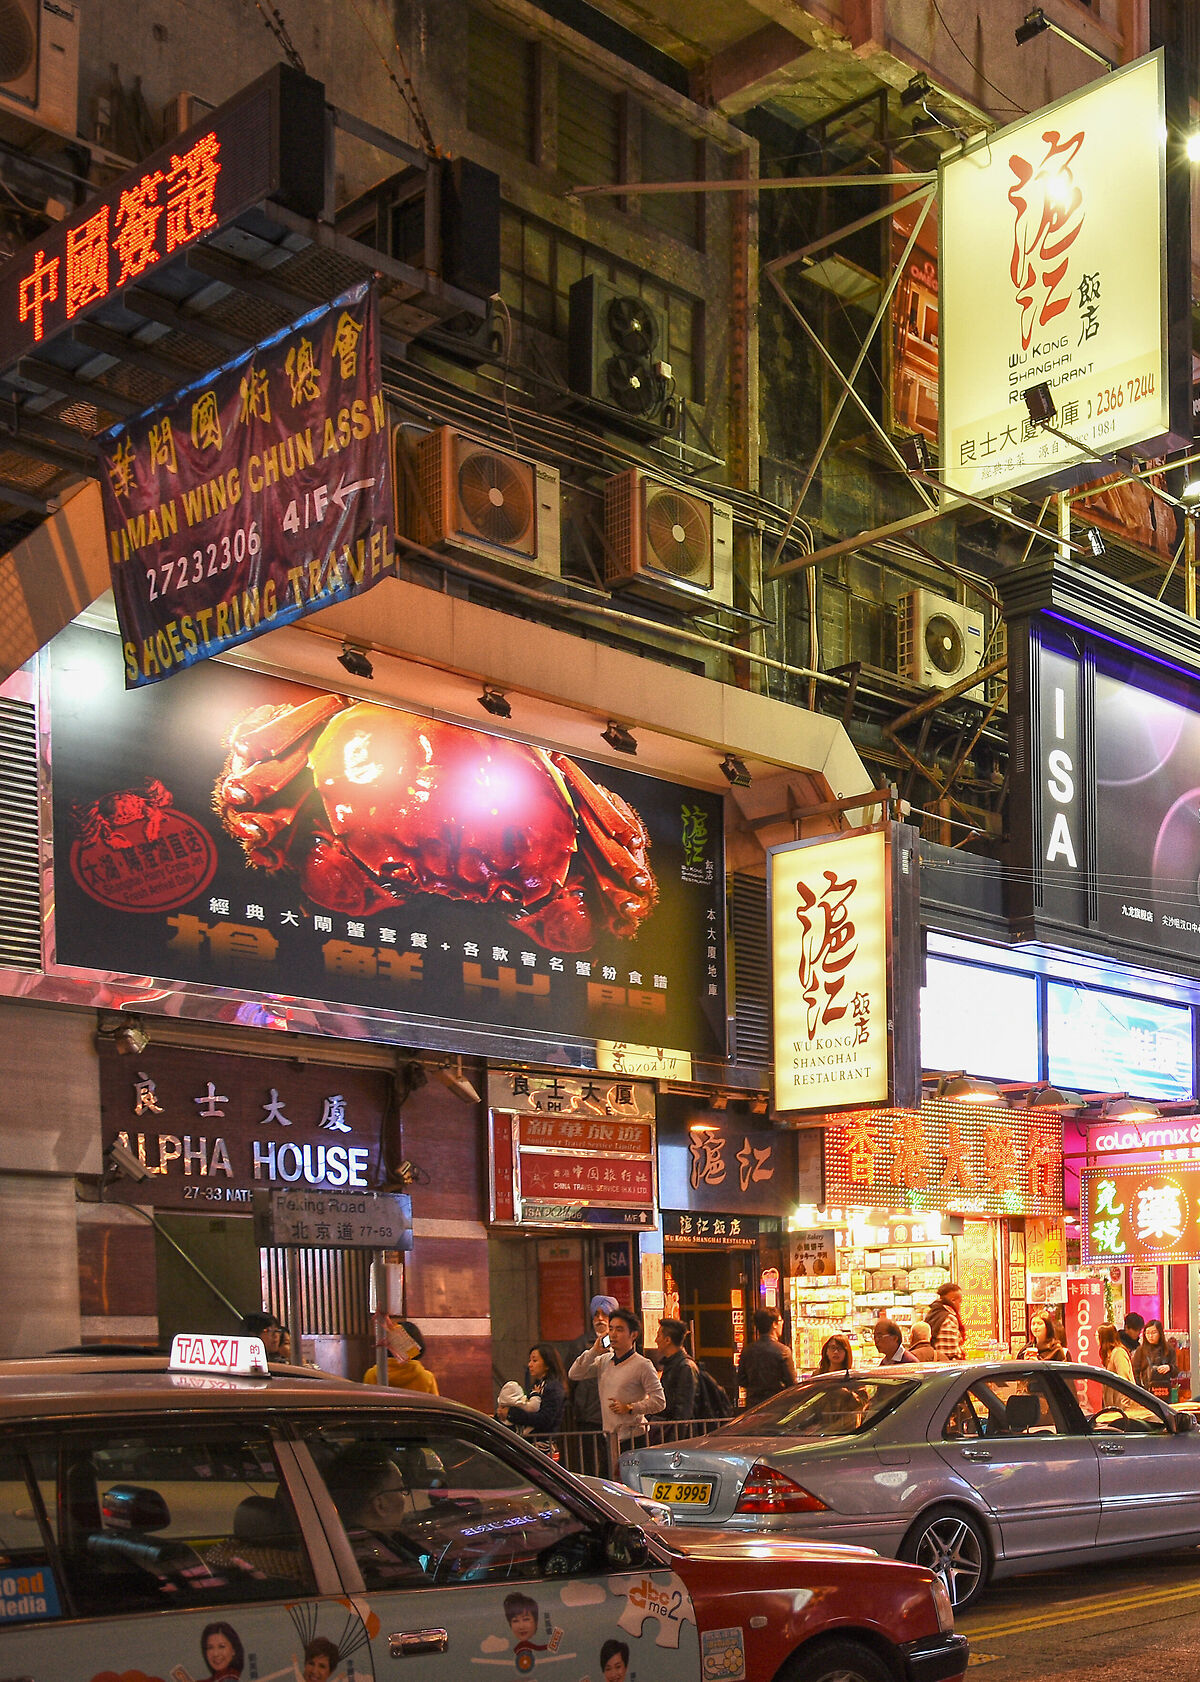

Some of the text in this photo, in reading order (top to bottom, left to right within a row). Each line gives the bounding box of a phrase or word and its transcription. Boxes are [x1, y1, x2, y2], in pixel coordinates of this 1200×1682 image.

[1077, 273, 1100, 346] 飯店
[1009, 363, 1094, 404] REAURANT
[1097, 384, 1123, 416] 2366
[1128, 373, 1155, 404] 7244
[1092, 418, 1116, 439] 1984
[181, 467, 242, 527] WING
[248, 428, 313, 495] CHUN
[146, 520, 261, 602] 27232306
[126, 524, 395, 682] SHOESTRING TRAVEL
[1046, 687, 1077, 868] ISA
[796, 870, 858, 1040] 滬江
[851, 991, 870, 1050] 飯店
[816, 1035, 851, 1050] KONG
[793, 1052, 857, 1070] SHANGHAI
[512, 1076, 633, 1105] 良士大廈
[794, 1067, 871, 1086] RESTAURANT
[134, 1071, 352, 1133] 良士大廈
[253, 1140, 369, 1186] HOUSE
[183, 1186, 222, 1201] 27-33
[596, 1185, 620, 1193] SERVICE
[329, 1199, 365, 1214] Road
[524, 1208, 541, 1218] ISA
[292, 1222, 392, 1241] 北京道 77-53
[607, 1252, 627, 1267] ISA
[177, 1337, 239, 1367] TAXI
[655, 1485, 708, 1501] SZ 3995
[0, 1571, 45, 1597] oad
